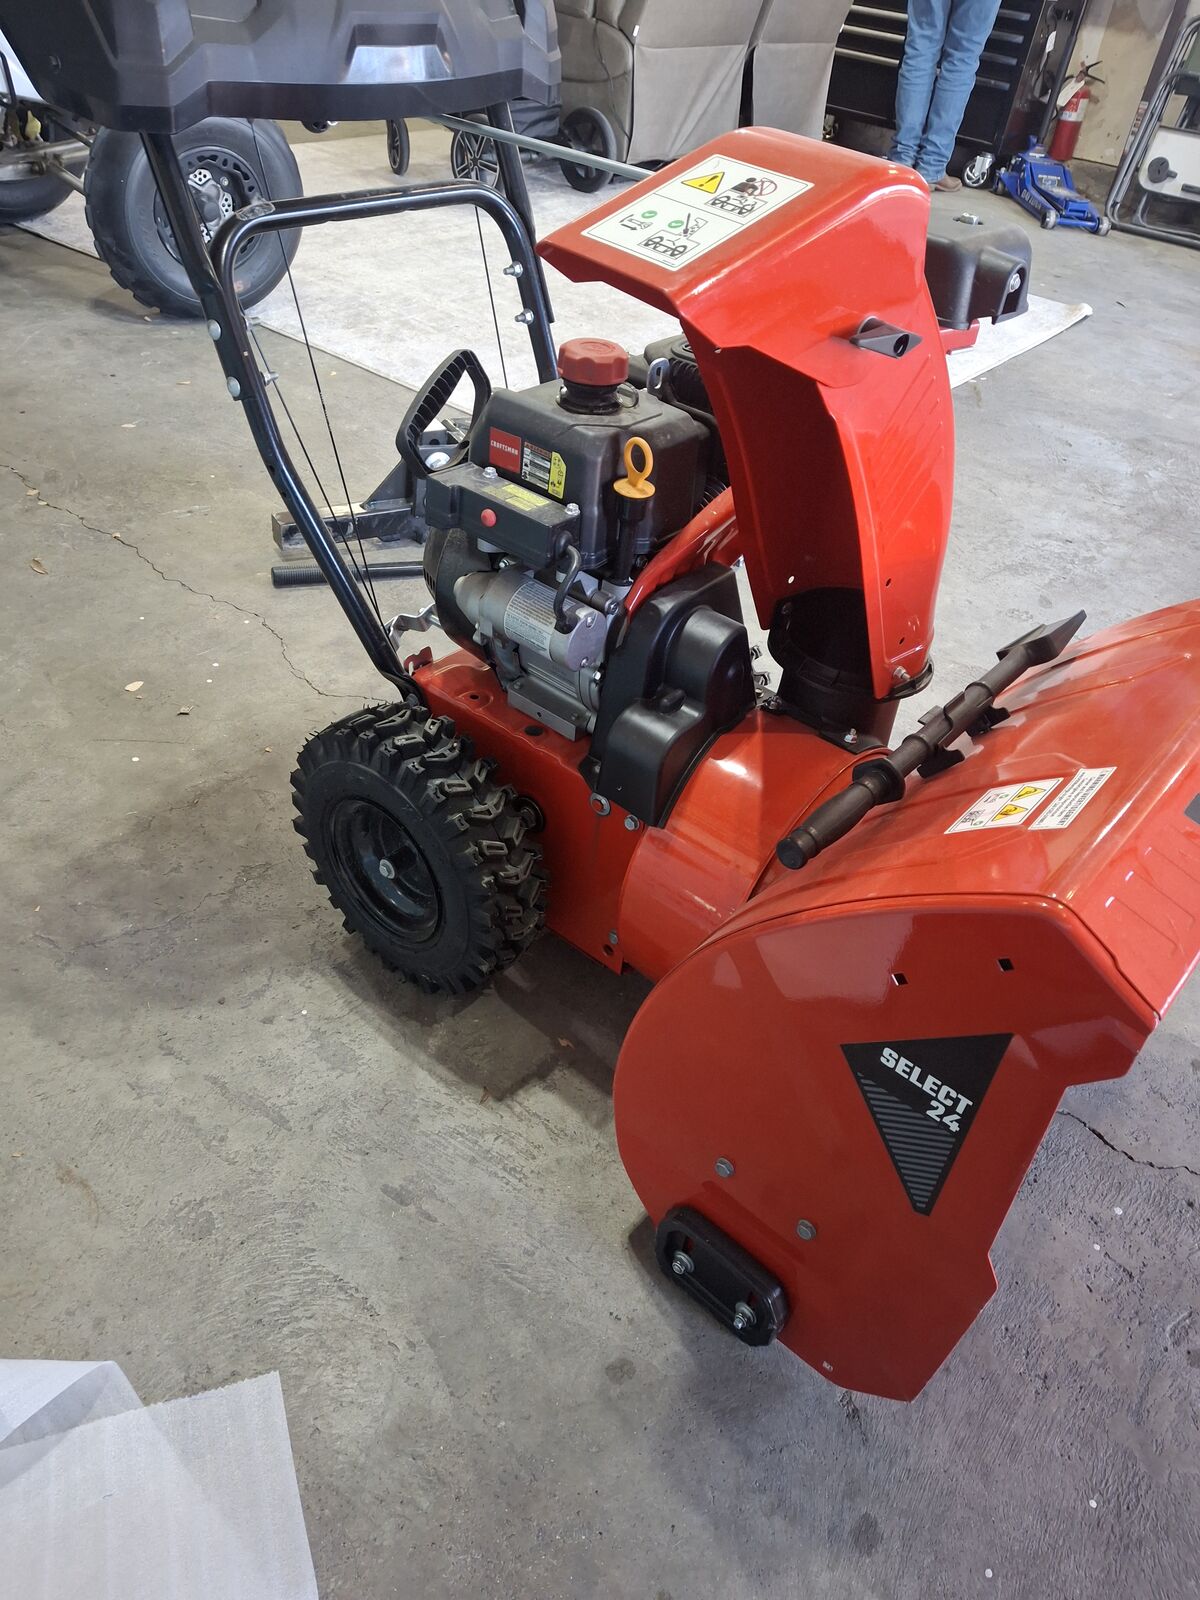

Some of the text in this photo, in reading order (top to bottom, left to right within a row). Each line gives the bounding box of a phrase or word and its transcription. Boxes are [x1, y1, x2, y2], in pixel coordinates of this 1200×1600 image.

[490, 440, 519, 456] CRAFTSMAN
[879, 1047, 974, 1115] SELECT
[925, 1100, 961, 1132] 24
